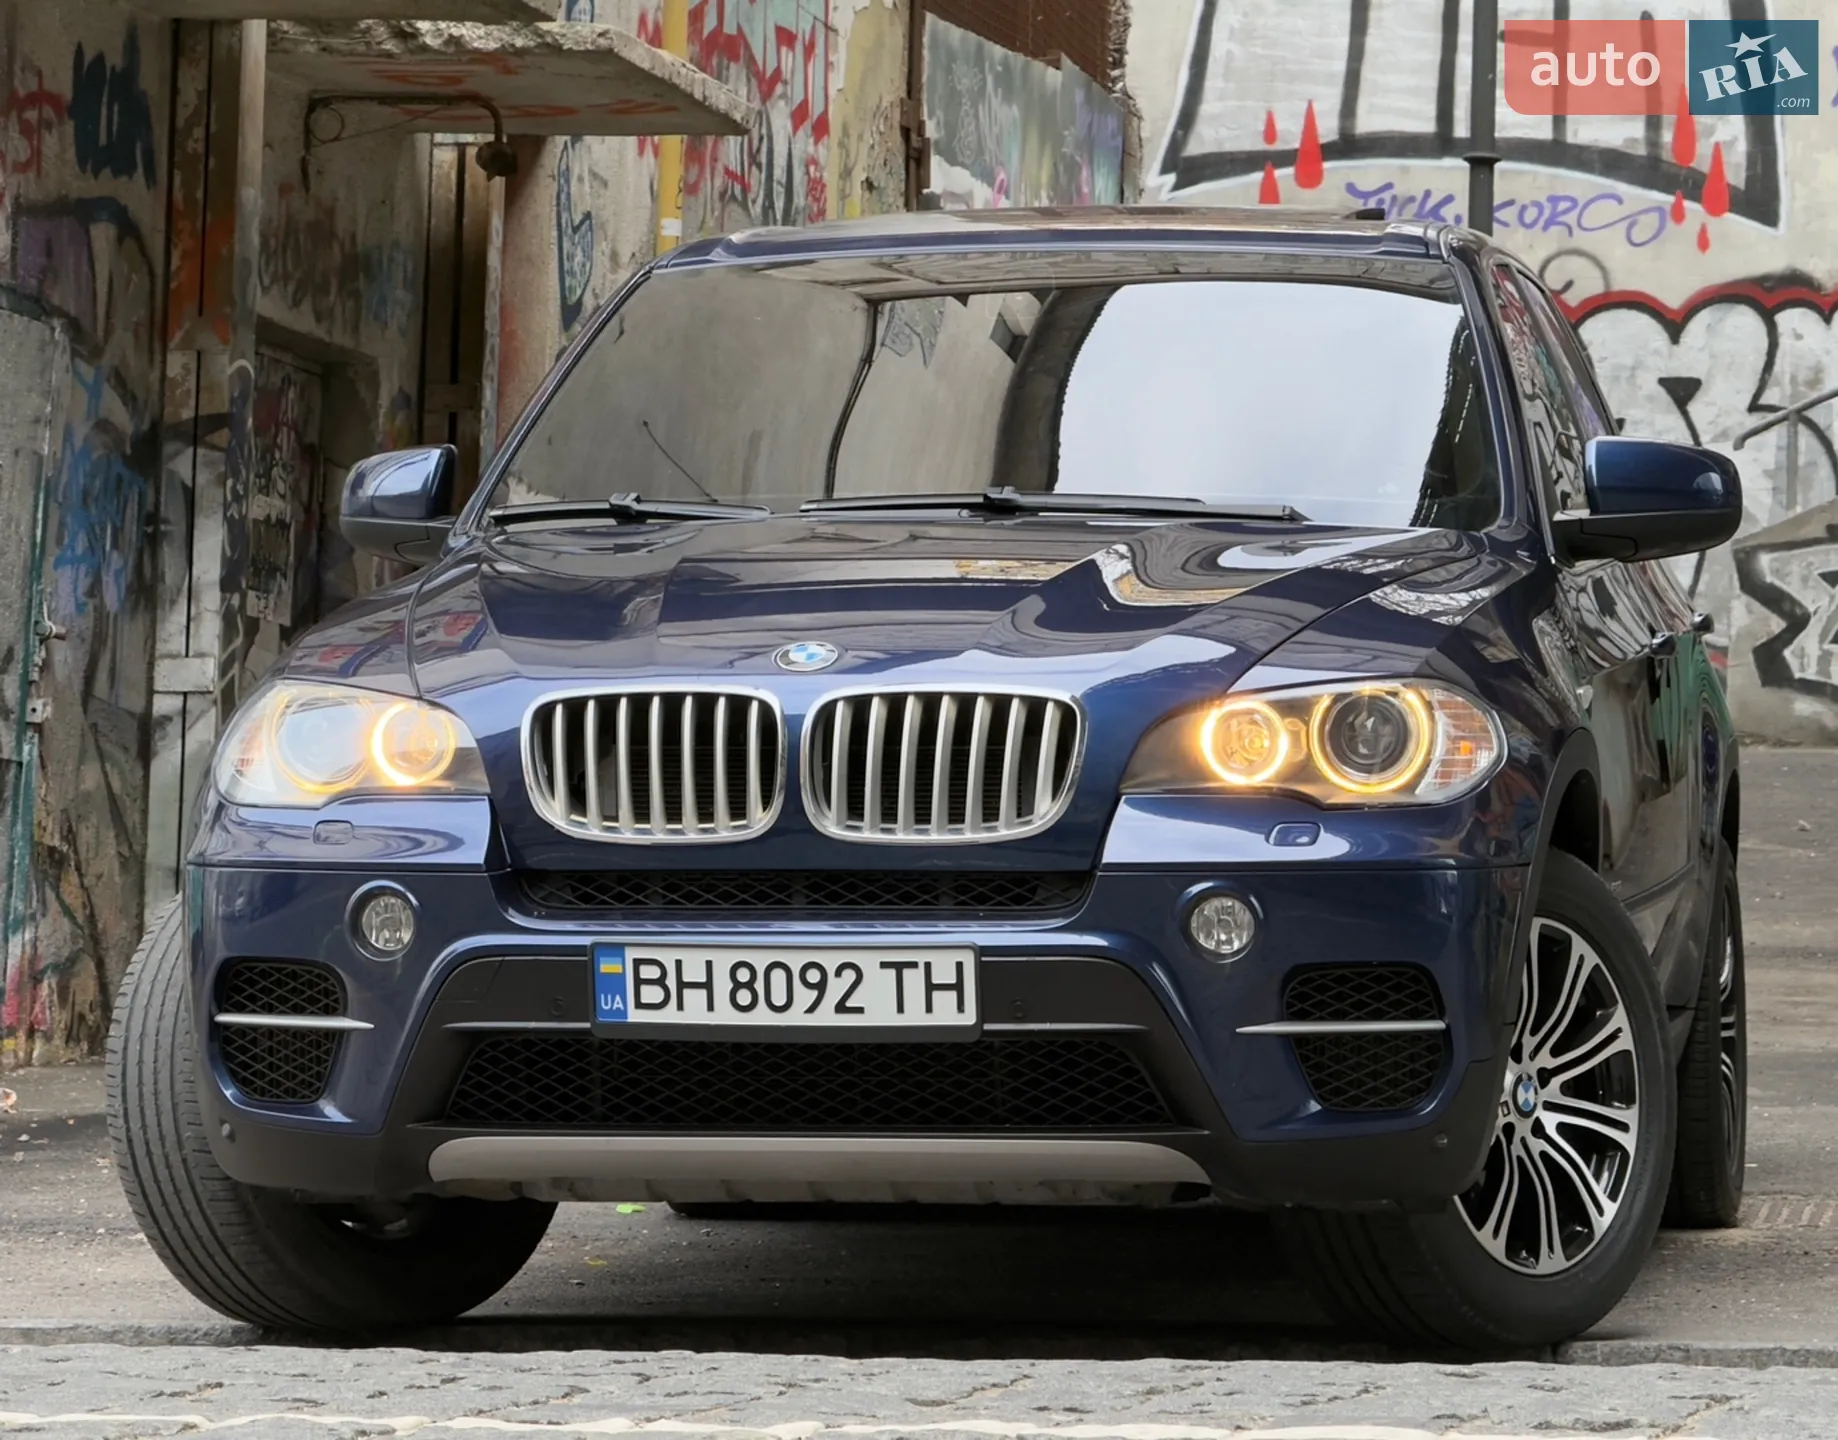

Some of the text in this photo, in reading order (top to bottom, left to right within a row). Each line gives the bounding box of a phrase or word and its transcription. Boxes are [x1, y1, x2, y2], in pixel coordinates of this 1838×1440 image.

[601, 994, 625, 1010] UA
[632, 957, 965, 1014] BH 8092 TH
